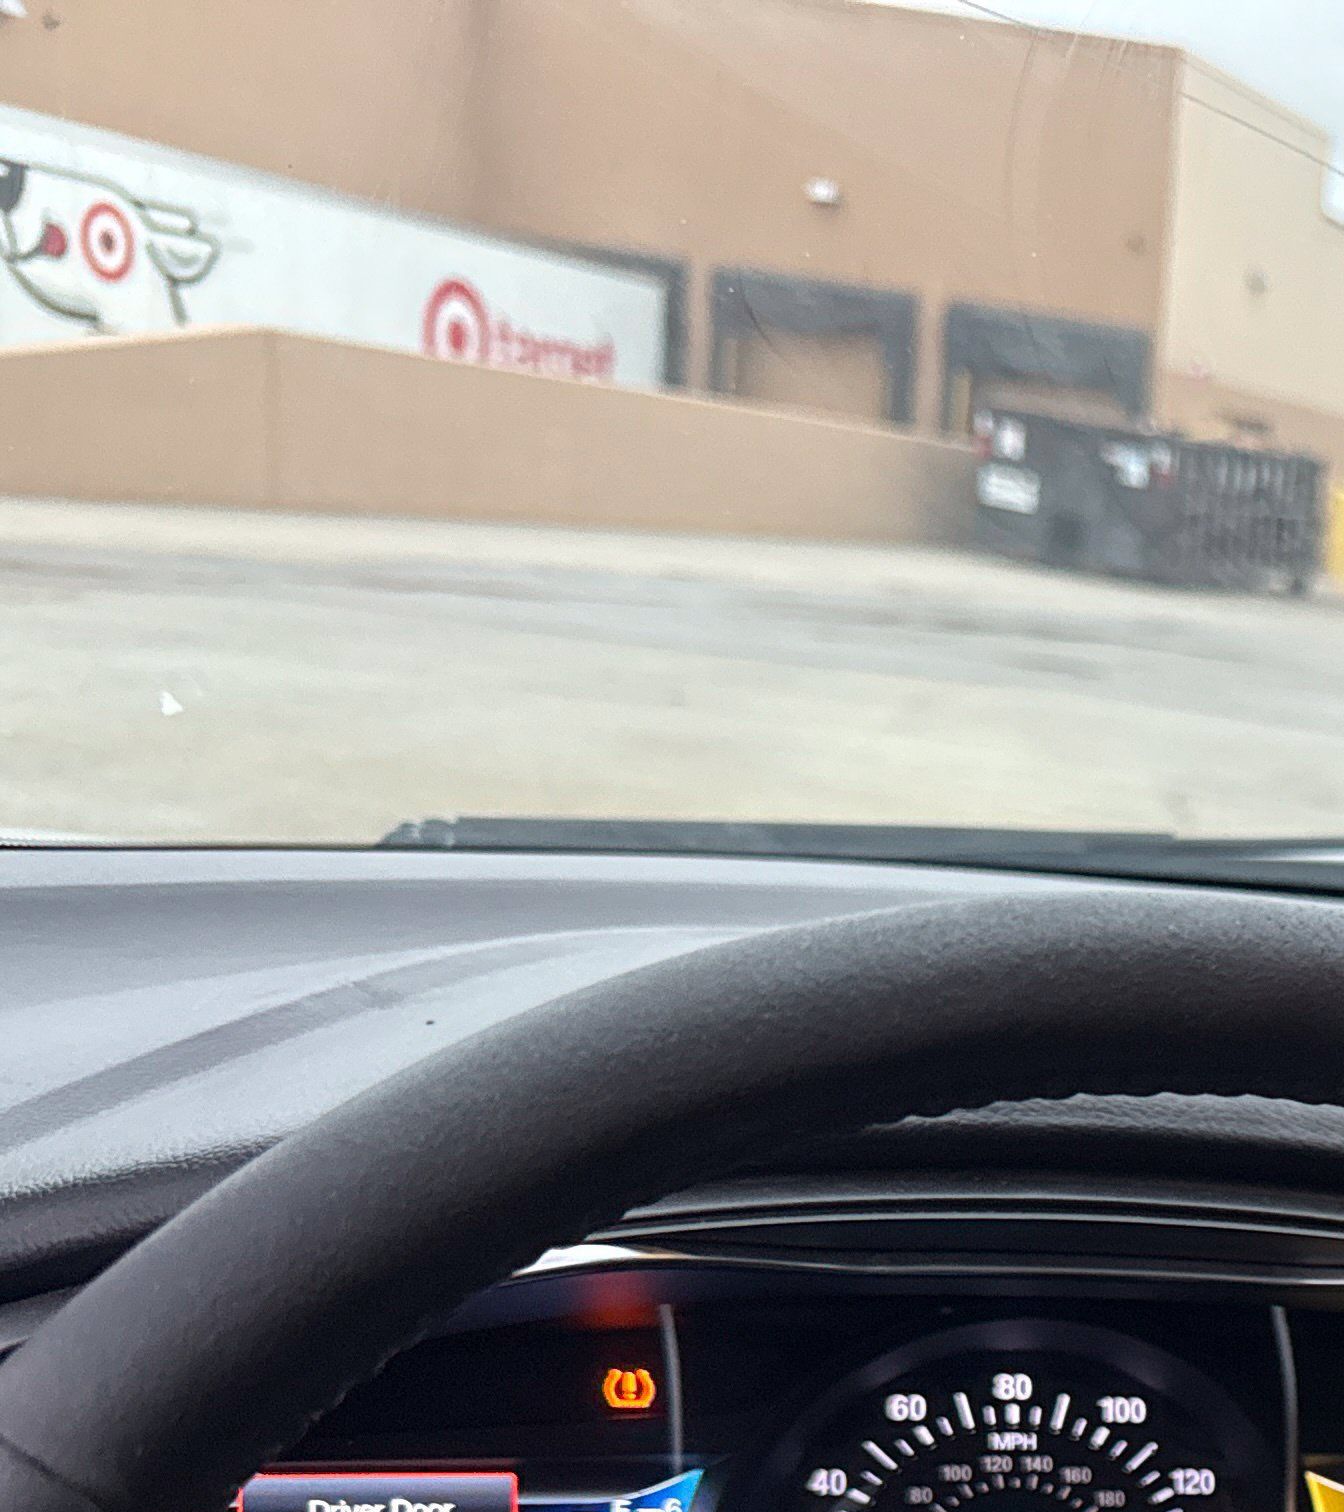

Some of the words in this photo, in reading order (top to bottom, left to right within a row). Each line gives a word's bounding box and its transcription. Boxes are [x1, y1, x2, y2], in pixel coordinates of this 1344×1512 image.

[992, 1373, 1033, 1400] 80
[885, 1394, 928, 1421] 60
[1098, 1396, 1147, 1424] 100
[987, 1432, 1038, 1452] MPH
[941, 1464, 973, 1483] 100
[981, 1455, 1014, 1473] 120
[1023, 1455, 1054, 1473] 140
[807, 1468, 849, 1496] 40
[1173, 1468, 1216, 1496] 120
